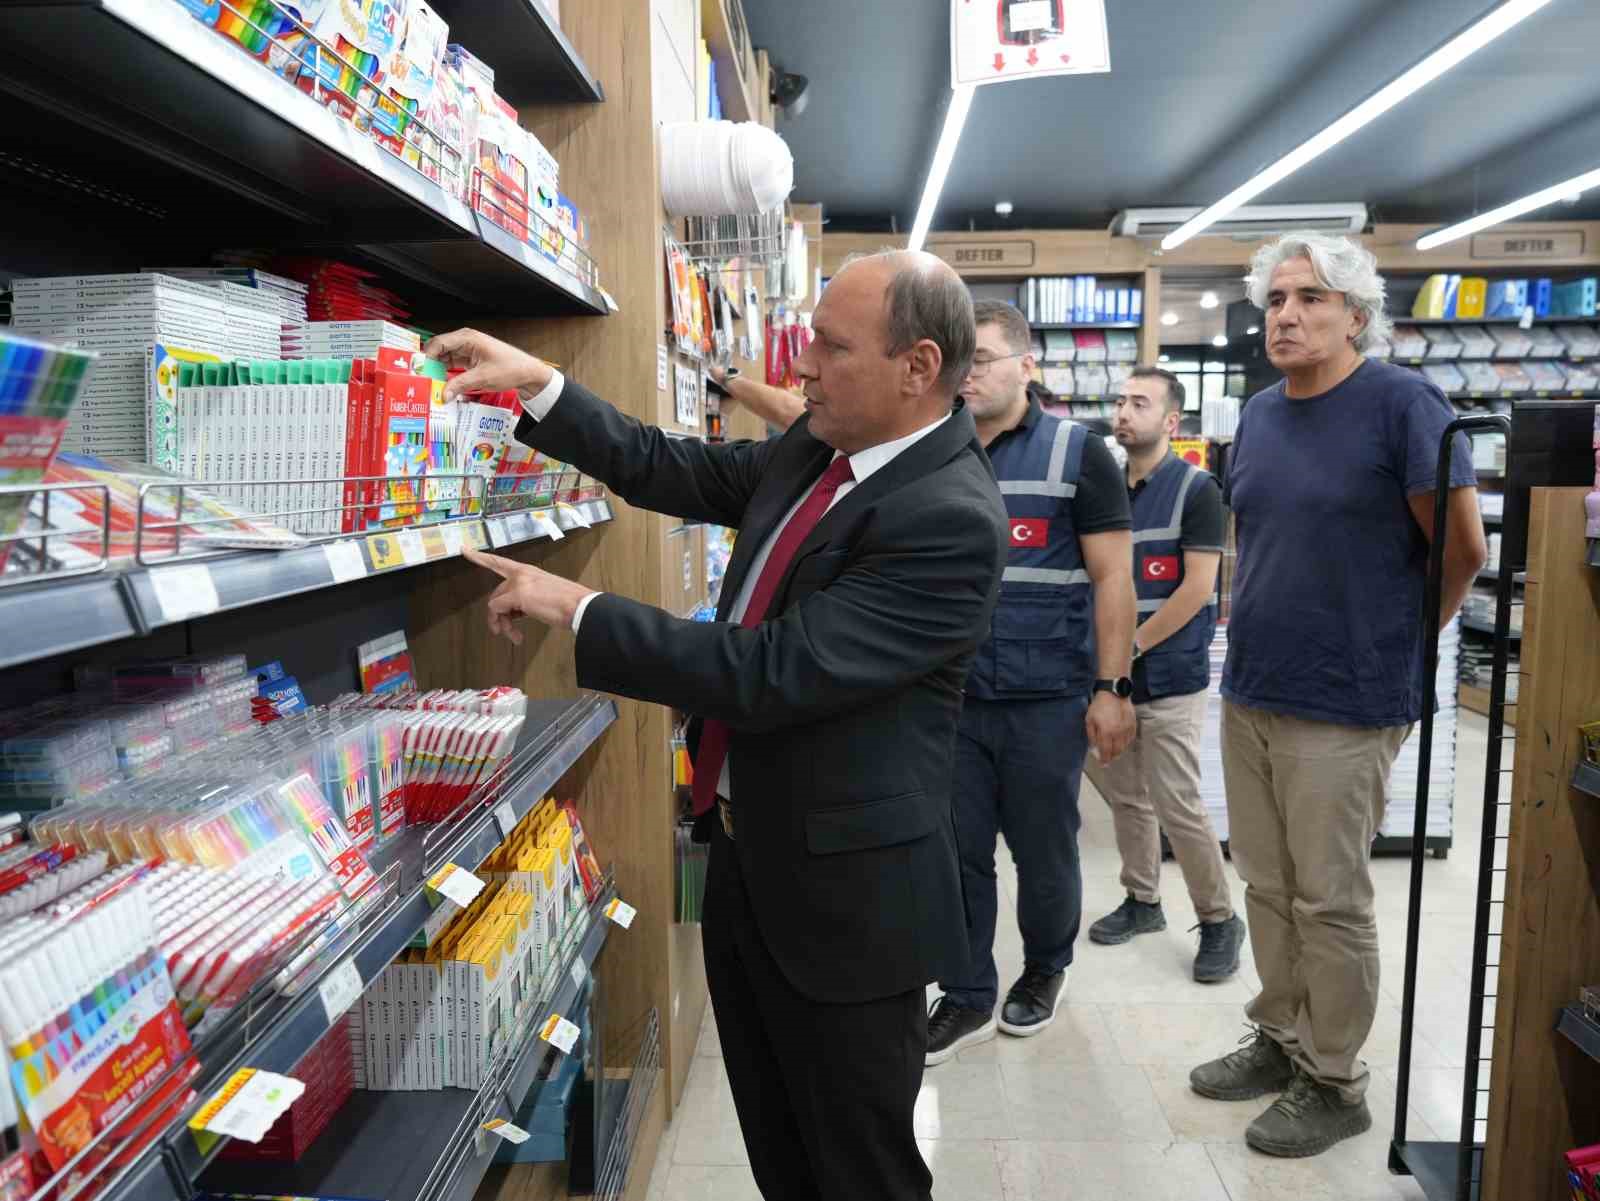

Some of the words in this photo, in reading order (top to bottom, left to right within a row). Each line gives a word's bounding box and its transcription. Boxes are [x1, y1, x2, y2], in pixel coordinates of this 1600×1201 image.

[1504, 239, 1552, 251] DEFTER
[955, 249, 1002, 261] DEFTER
[390, 398, 427, 414] FABER-CASTELL
[479, 416, 504, 432] GIOTTO
